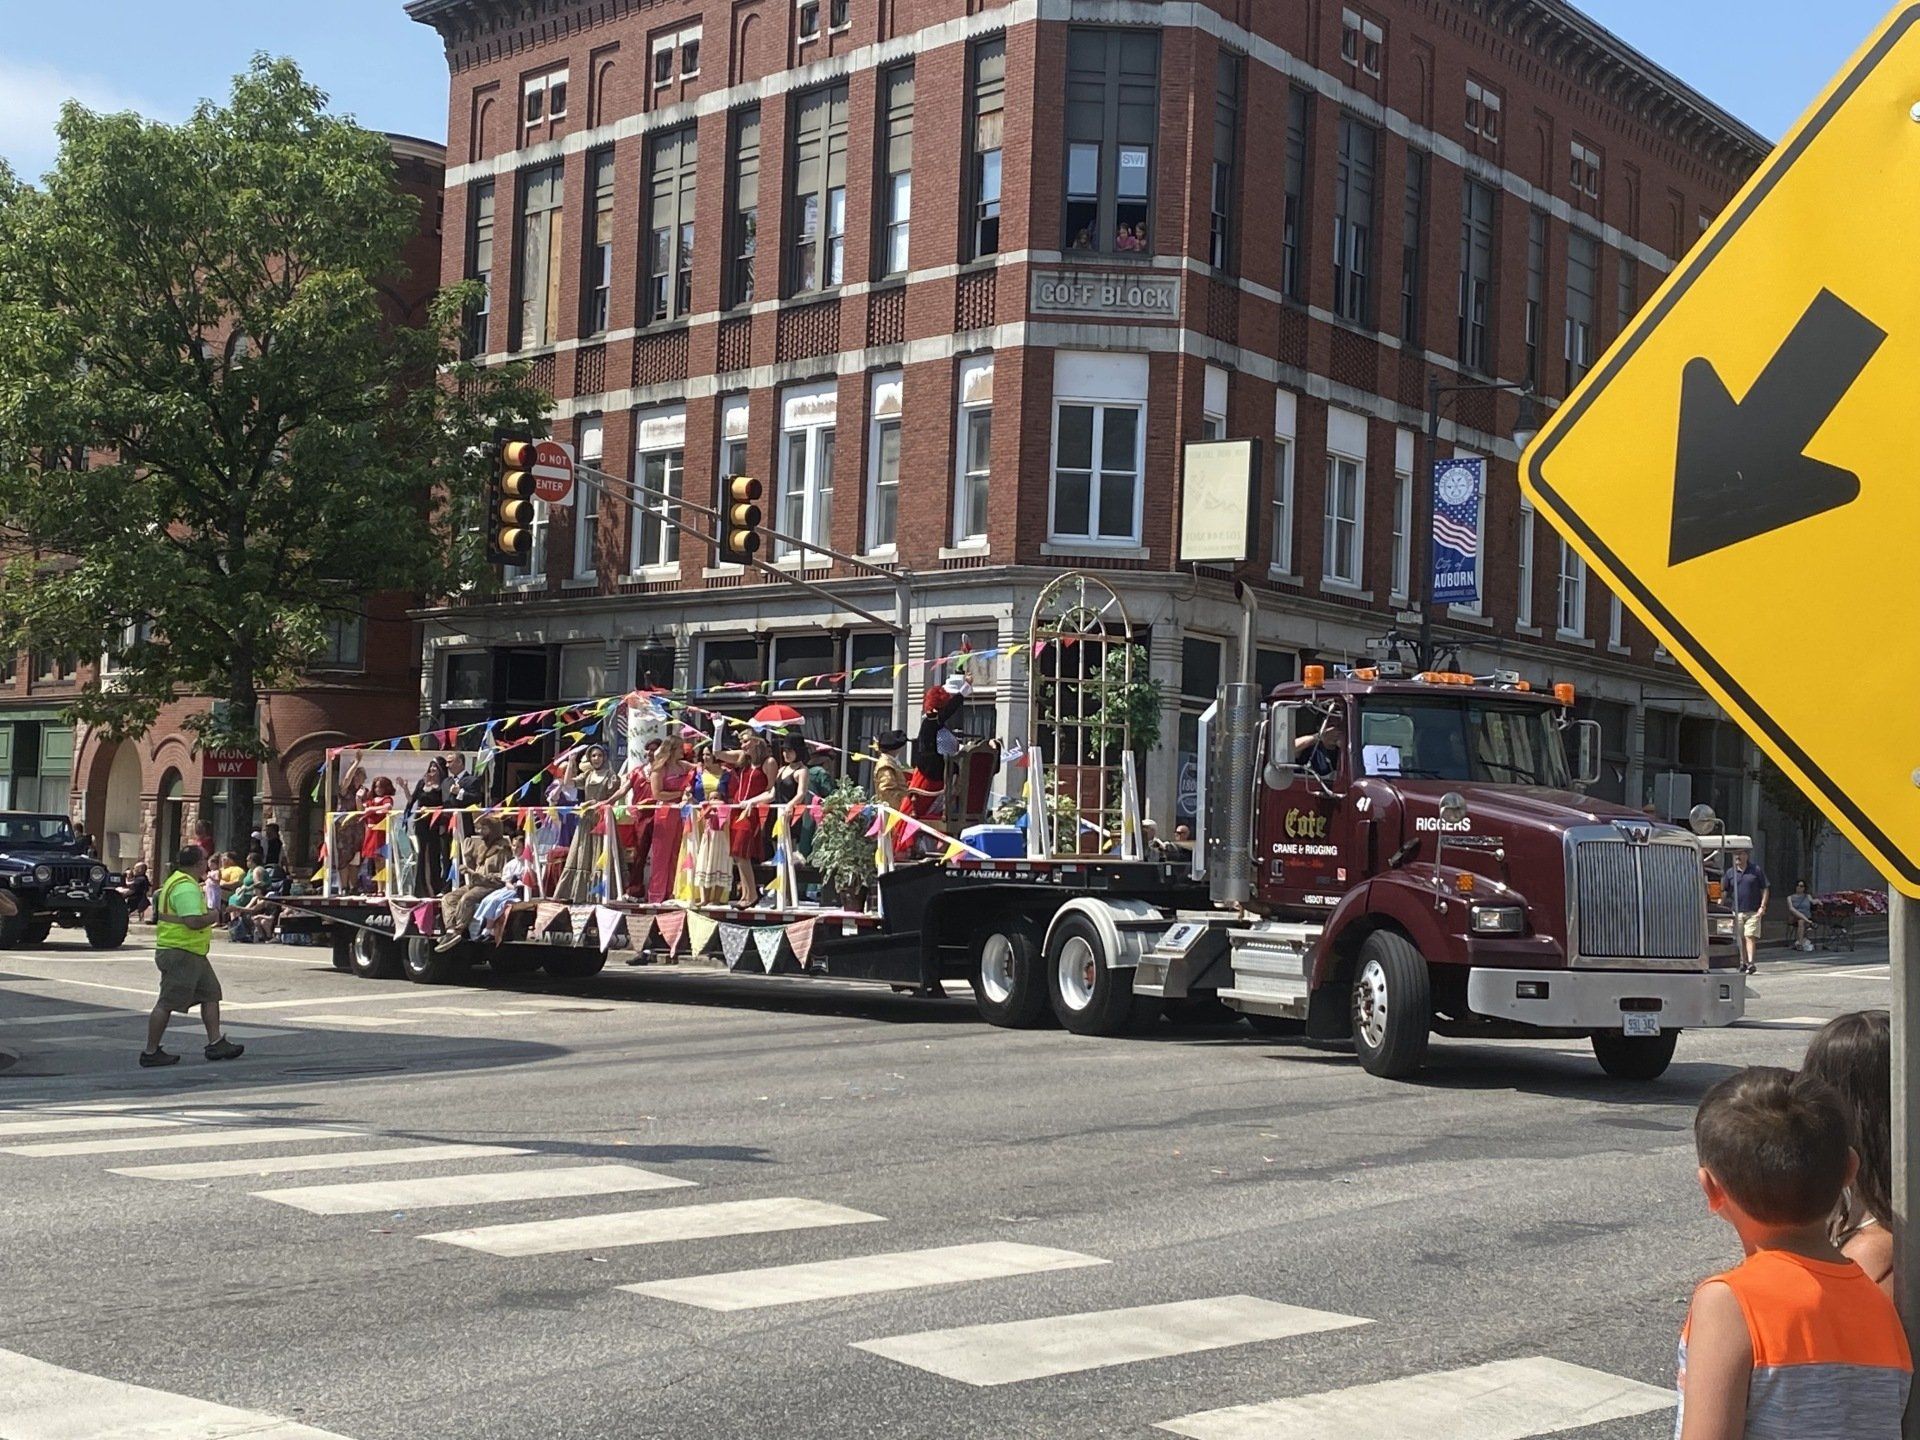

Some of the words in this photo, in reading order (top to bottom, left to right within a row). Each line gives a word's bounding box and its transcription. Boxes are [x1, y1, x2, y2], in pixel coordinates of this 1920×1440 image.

[1040, 283, 1094, 305] GOFF
[1101, 286, 1170, 308] BLOCK
[537, 452, 546, 463] O
[549, 454, 567, 466] NOT
[536, 479, 564, 491] ENTER
[1434, 570, 1474, 588] AUBURN
[209, 749, 252, 760] WRONG
[1375, 753, 1389, 767] 14
[217, 762, 243, 772] WAY
[1416, 817, 1471, 832] RIGGERS
[1272, 843, 1298, 854] CRANE
[1305, 845, 1338, 856] RIGGING
